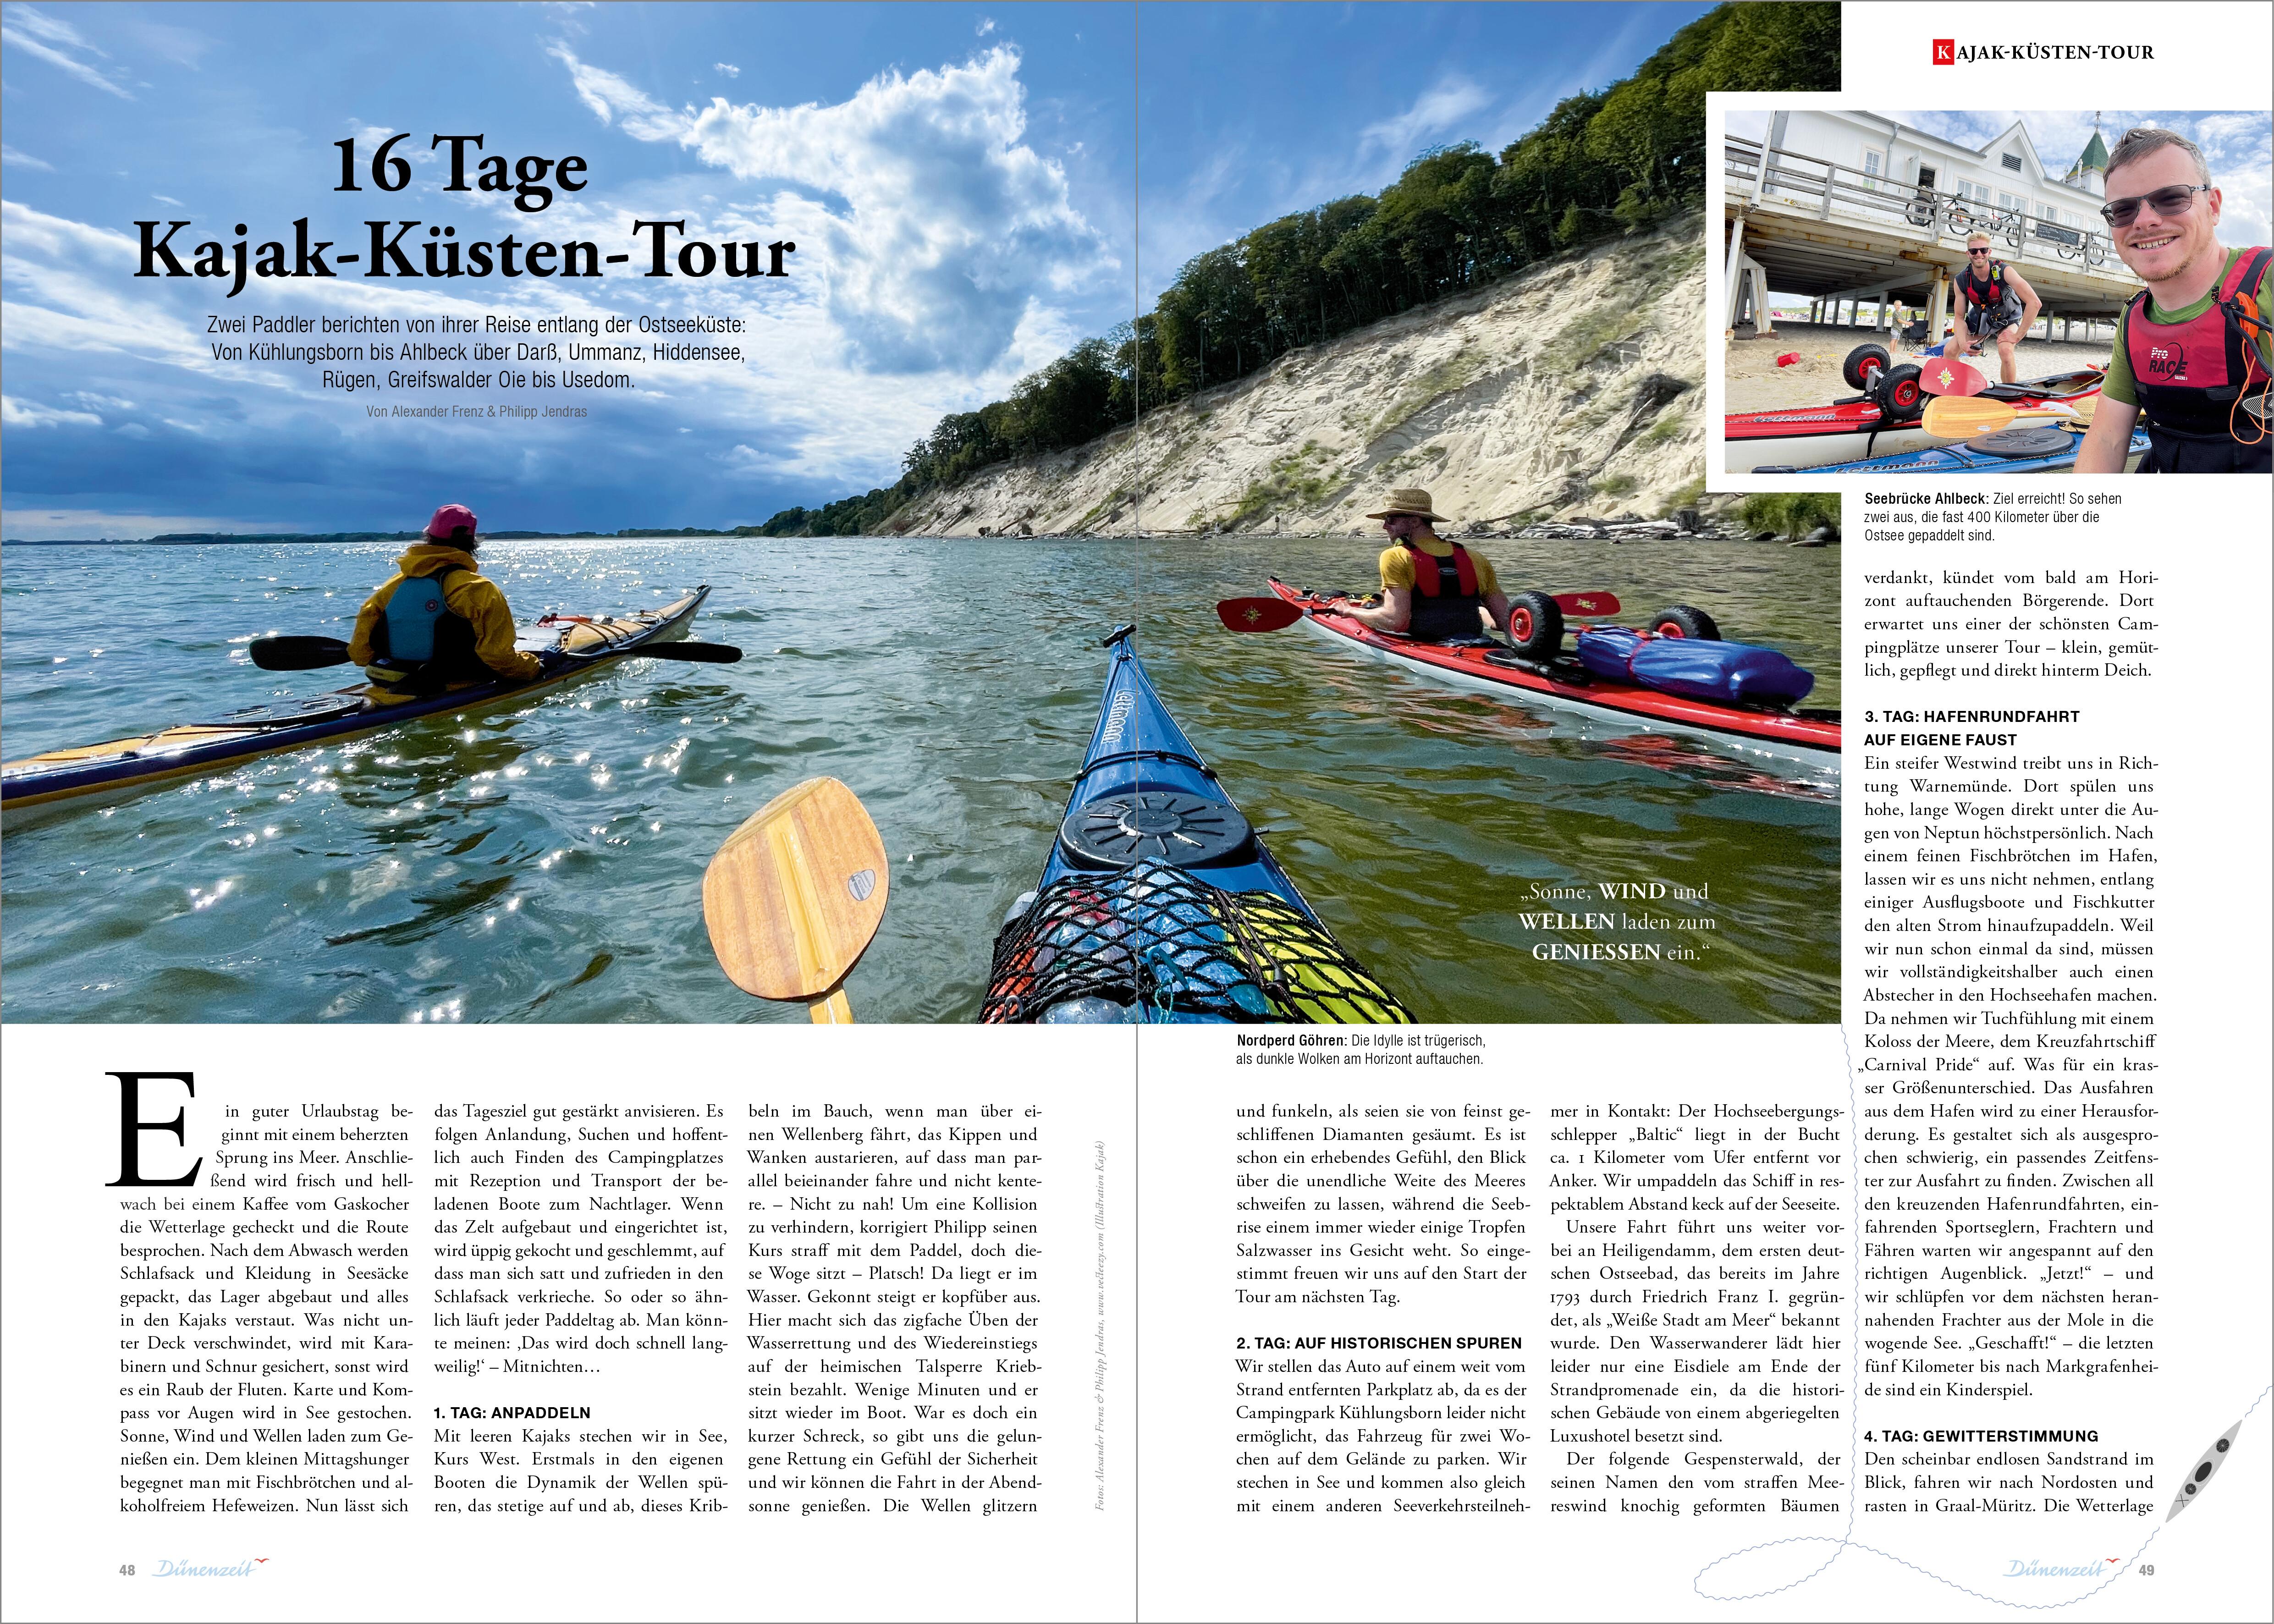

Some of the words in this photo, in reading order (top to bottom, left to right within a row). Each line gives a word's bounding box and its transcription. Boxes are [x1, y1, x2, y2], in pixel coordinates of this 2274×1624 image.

[334, 133, 411, 192] 16
[431, 133, 588, 213] Tage
[134, 217, 795, 298] Kajak-Küsten-Tour
[207, 315, 245, 333] Zwei
[253, 315, 316, 333] Paddler
[323, 315, 399, 333] berichten
[406, 319, 434, 333] von
[442, 315, 479, 333] ihrer
[486, 315, 530, 333] Reise
[538, 315, 598, 337] entlang
[606, 315, 633, 333] der
[639, 315, 745, 333] Ostseeküste:
[211, 343, 242, 360] Von
[250, 343, 363, 364] Kühlungsborn
[371, 343, 394, 360] bis
[400, 343, 468, 360] Ahlbeck
[474, 343, 511, 360] über
[518, 343, 561, 363] Darß,
[569, 343, 645, 363] Ummanz,
[654, 343, 744, 363] Hiddensee,
[2151, 347, 2168, 359] Pro
[2148, 360, 2188, 375] RACE
[324, 370, 380, 392] Rügen,
[389, 370, 492, 388] Greifswalder
[499, 370, 525, 388] Oie
[533, 370, 556, 388] bis
[563, 370, 634, 388] Usedom.
[366, 405, 387, 417] Von
[392, 405, 448, 417] Alexander
[453, 405, 483, 417] Frenz
[487, 405, 495, 417] &
[500, 405, 538, 419] Philipp
[542, 406, 587, 417] Jendras
[1834, 460, 1939, 473] Lettmann
[1865, 492, 1931, 504] Seebrücke
[1935, 492, 1989, 504] Ahlbeck:
[1993, 492, 2013, 504] Ziel
[2018, 492, 2065, 504] erreicht!
[2070, 492, 2084, 504] So
[2088, 492, 2121, 504] sehen
[1864, 511, 1889, 523] zwei
[1894, 513, 1916, 525] aus,
[1922, 511, 1938, 523] die
[1942, 511, 1964, 523] fast
[1967, 511, 1991, 523] 400
[1995, 511, 2049, 523] Kilometer
[2054, 511, 2079, 523] über
[2082, 511, 2099, 523] die
[1865, 529, 1904, 541] Ostsee
[1908, 529, 1965, 544] gepaddelt
[1968, 529, 1994, 541] sind.
[1864, 570, 1933, 585] verdankt,
[1943, 570, 1994, 584] kündet
[2004, 575, 2035, 584] vom
[2045, 570, 2076, 584] bald
[2086, 575, 2109, 584] am
[2119, 570, 2158, 584] Hori-
[1865, 710, 1878, 722] 3.
[1883, 710, 1919, 722] TAG:
[1924, 710, 2080, 722] HAFENRUNDFAHRT
[1864, 734, 1896, 746] AUF
[1901, 734, 1961, 746] EIGENE
[1966, 734, 2017, 746] FAUST
[1521, 883, 1591, 901] „Sonne,
[1597, 883, 1666, 899] WIND
[1673, 882, 1709, 899] und
[1518, 913, 1615, 930] WELLEN
[1623, 913, 1669, 930] laden
[1678, 919, 1715, 930] zum
[1532, 943, 1661, 960] GENIESSEN
[1668, 943, 1710, 960] ein.“
[1238, 1034, 1294, 1049] Nordperd
[1299, 1034, 1347, 1046] Göhren:
[1352, 1034, 1370, 1046] Die
[1374, 1034, 1403, 1049] Idylle
[1408, 1034, 1421, 1046] ist
[1424, 1034, 1485, 1049] trügerisch,
[1236, 1052, 1252, 1064] als
[1256, 1052, 1294, 1064] dunkle
[1298, 1052, 1339, 1064] Wolken
[1344, 1055, 1361, 1064] am
[1366, 1052, 1412, 1064] Horizont
[1416, 1052, 1483, 1064] auftauchen.
[226, 1105, 240, 1117] in
[252, 1107, 289, 1122] guter
[301, 1103, 379, 1122] Urlaubstag
[391, 1103, 413, 1117] be-
[435, 1103, 457, 1118] das
[463, 1103, 527, 1122] Tagesziel
[533, 1107, 557, 1122] gut
[562, 1103, 619, 1122] gestärkt
[625, 1105, 699, 1117] anvisieren.
[706, 1104, 723, 1117] Es
[1550, 1108, 1578, 1117] mer
[1586, 1105, 1599, 1117] in
[1608, 1103, 1670, 1117] Kontakt:
[1678, 1104, 1706, 1117] Der
[1713, 1103, 1845, 1122] Hochseebergungs-
[1095, 1141, 1107, 1173] Kajak)
[1095, 1175, 1106, 1230] (Illustration
[749, 1224, 765, 1233] zu
[771, 1219, 853, 1235] verhindern,
[859, 1219, 928, 1238] korrigiert
[934, 1219, 986, 1238] Philipp
[993, 1221, 1038, 1233] seinen
[1095, 1233, 1107, 1316] www.vecteezy.com
[1095, 1319, 1106, 1357] Jendras,
[1237, 1337, 1250, 1349] 2.
[1254, 1337, 1290, 1349] TAG:
[1294, 1337, 1326, 1349] AUF
[1331, 1337, 1451, 1349] HISTORISCHEN
[1456, 1337, 1521, 1349] SPUREN
[1095, 1358, 1107, 1393] Philipp
[1094, 1393, 1104, 1404] &
[434, 1407, 445, 1419] 1.
[450, 1407, 486, 1419] TAG:
[491, 1407, 590, 1419] ANPADDELN
[1095, 1406, 1104, 1433] Frenz
[1236, 1405, 1335, 1423] Campingpark
[1339, 1405, 1443, 1423] Kühlungsborn
[1446, 1405, 1486, 1419] leider
[1490, 1405, 1526, 1419] nicht
[1864, 1431, 1877, 1442] 4.
[1882, 1430, 1918, 1442] TAG:
[1923, 1430, 2098, 1442] GEWITTERSTIMMUNG
[1095, 1435, 1104, 1483] Alexander
[120, 1498, 206, 1512] koholfreiem
[212, 1498, 298, 1512] Hefeweizen.
[306, 1498, 339, 1512] Nun
[344, 1498, 375, 1512] lässt
[381, 1498, 409, 1512] sich
[749, 1503, 790, 1512] sonne
[802, 1498, 870, 1516] genießen.
[883, 1498, 909, 1512] Die
[920, 1498, 971, 1512] Wellen
[983, 1498, 1038, 1516] glitzern
[1095, 1485, 1104, 1511] Fotos:
[1551, 1498, 1607, 1512] reswind
[1620, 1498, 1680, 1516] knochig
[1693, 1498, 1766, 1516] geformten
[1781, 1498, 1840, 1512] Bäumen
[1865, 1502, 1907, 1512] rasten
[1914, 1499, 1929, 1512] in
[1936, 1498, 2036, 1512] Graal-Müritz.
[2043, 1498, 2070, 1512] Die
[2076, 1498, 2153, 1516] Wetterlage
[119, 1564, 135, 1576] 48
[151, 1559, 257, 1577] Dünenzeit
[2002, 1559, 2109, 1577] Dünenzeit
[2139, 1564, 2154, 1576] 49
